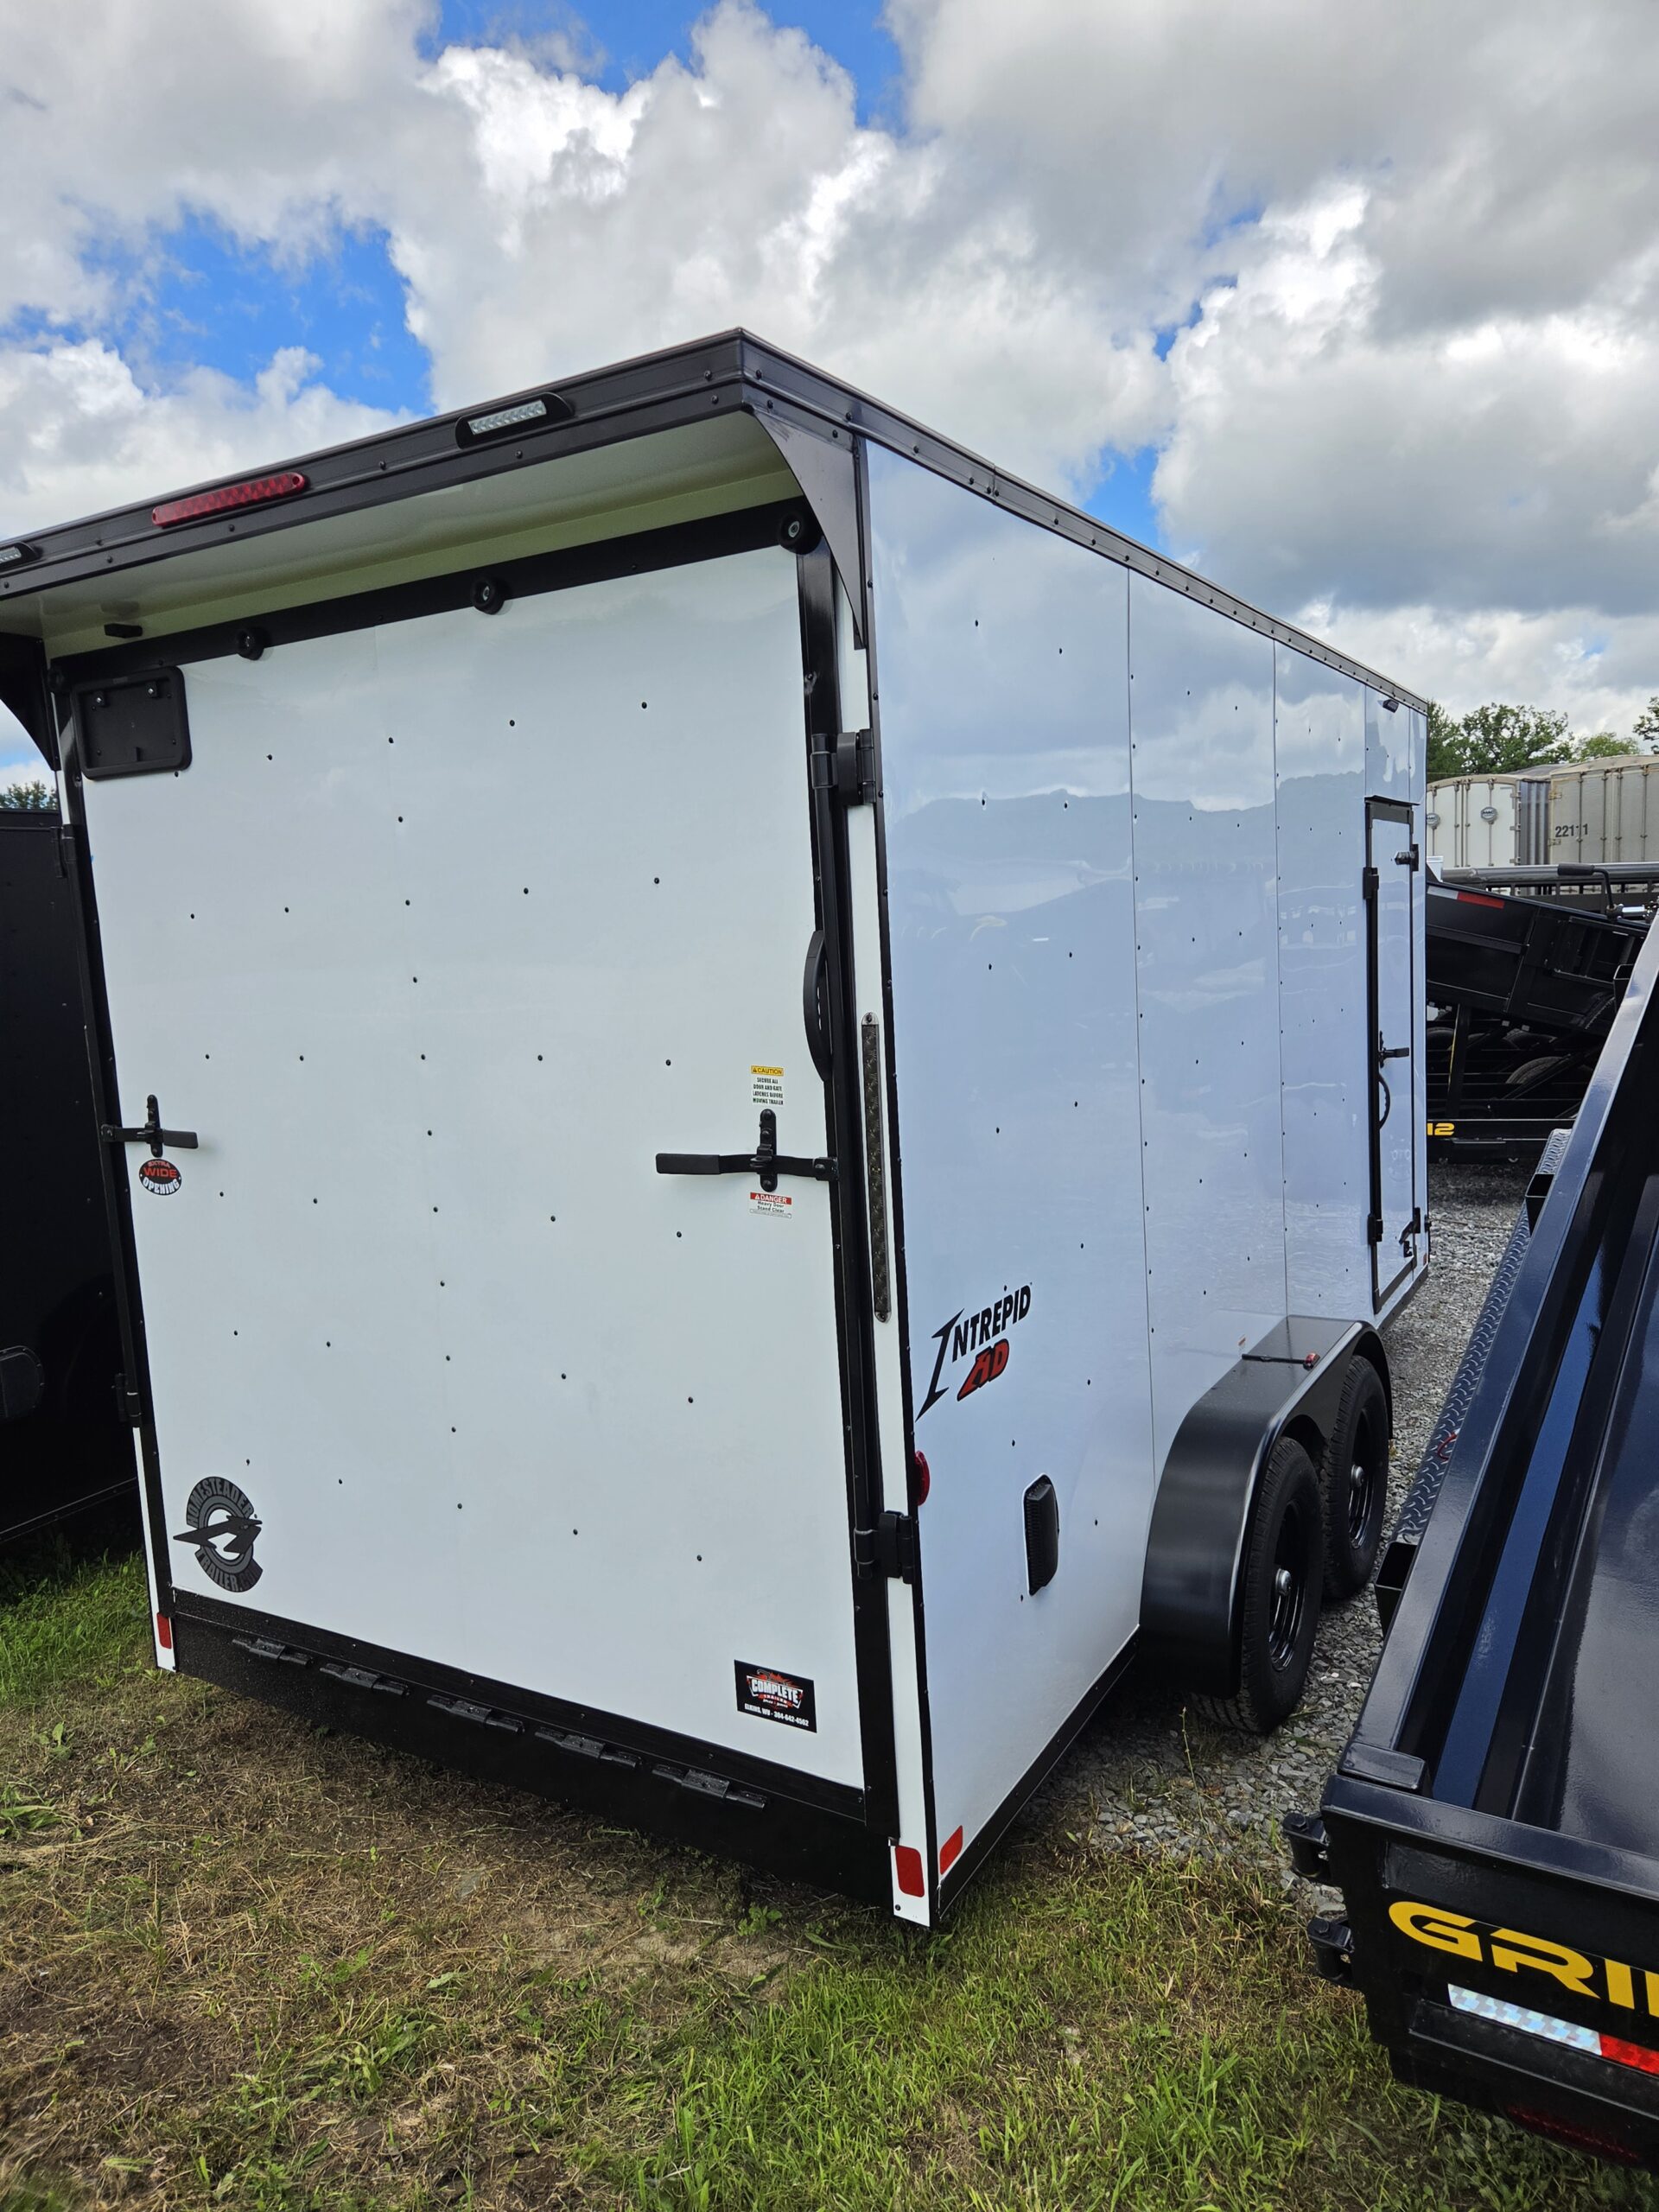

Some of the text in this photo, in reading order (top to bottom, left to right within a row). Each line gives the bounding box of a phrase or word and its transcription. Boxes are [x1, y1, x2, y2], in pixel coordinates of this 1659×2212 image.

[1555, 823, 1588, 837] 2211
[1427, 1123, 1455, 1135] 12
[144, 1167, 178, 1179] WIDE
[143, 1177, 180, 1194] OPENING
[760, 1194, 787, 1204] DANGER
[915, 1285, 1031, 1422] INTREPID
[187, 1478, 254, 1528] HOMESTEADER
[751, 1679, 798, 1704] COMPLETE
